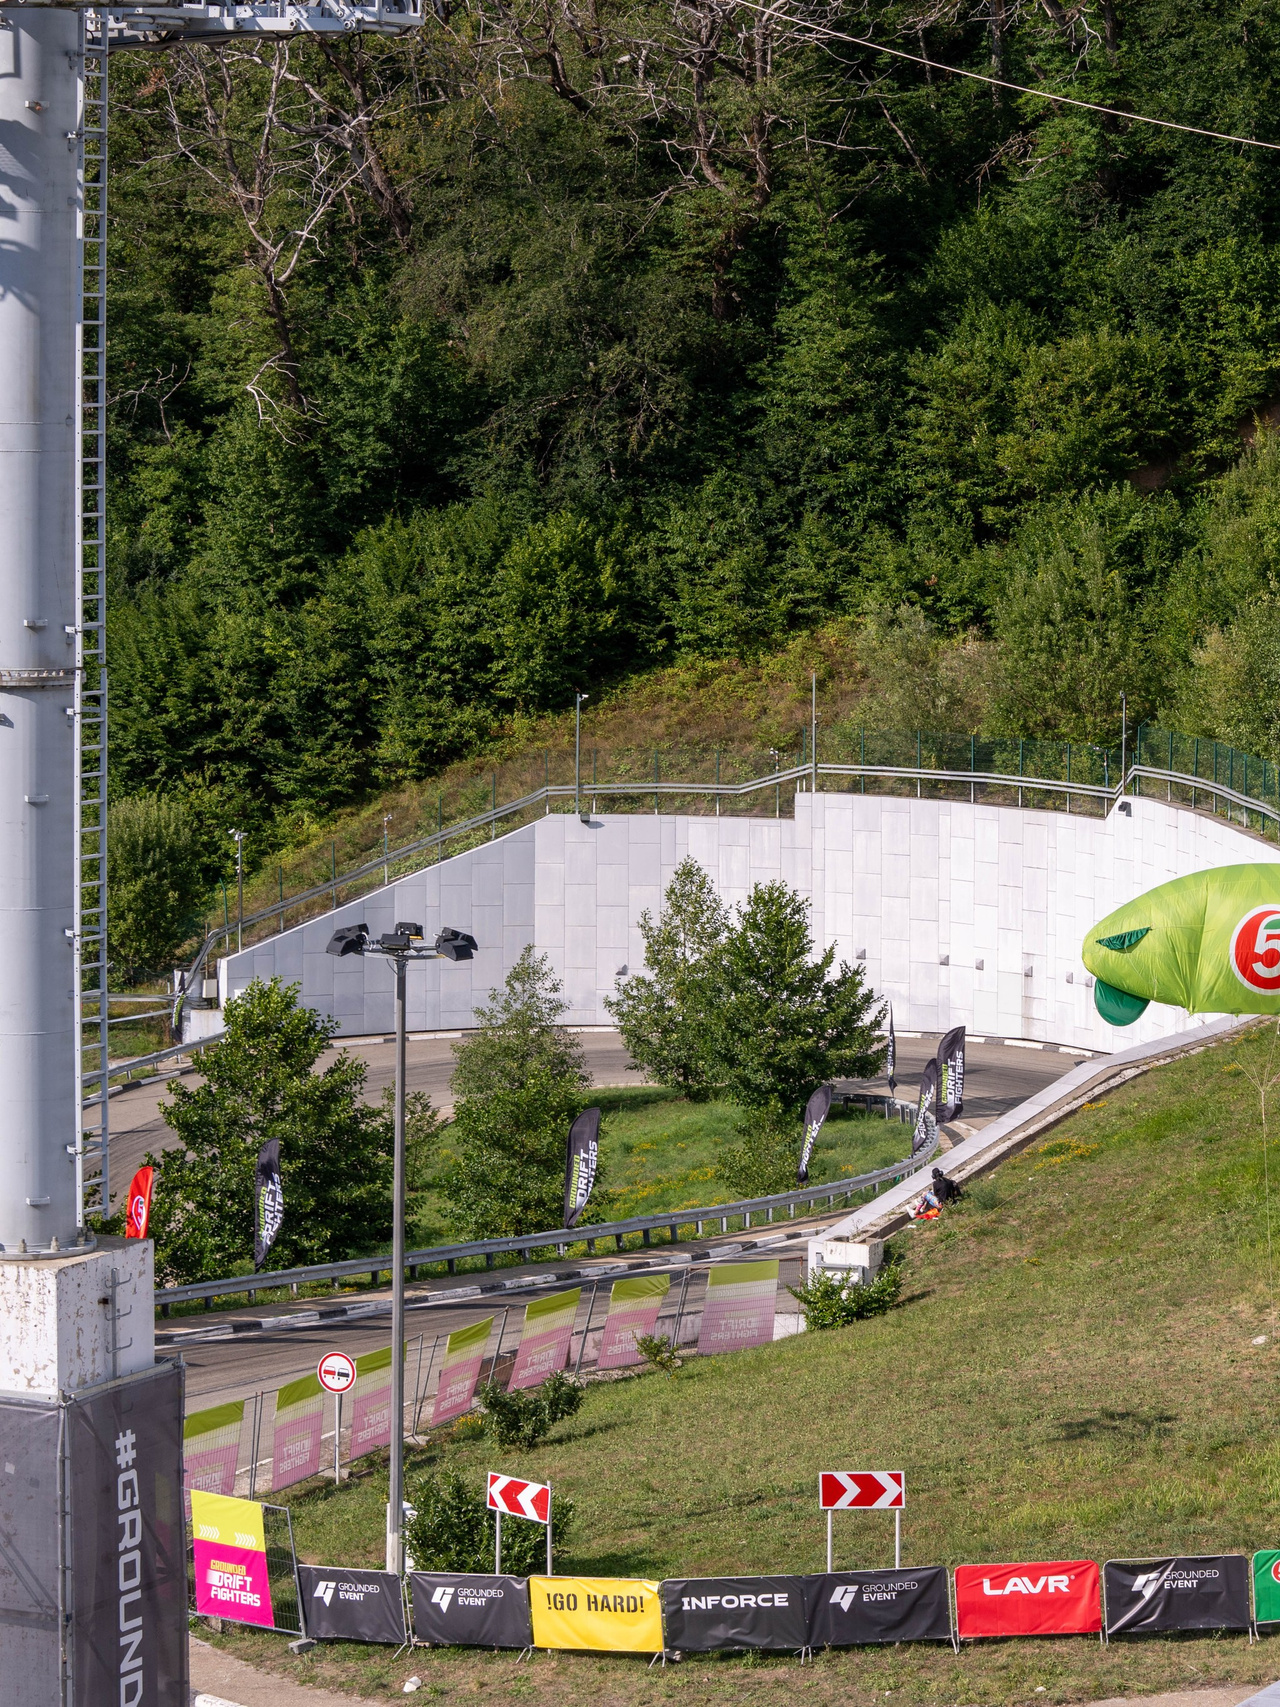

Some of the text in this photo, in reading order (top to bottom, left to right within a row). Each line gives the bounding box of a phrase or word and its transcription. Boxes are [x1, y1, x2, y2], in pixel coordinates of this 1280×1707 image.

[947, 1059, 957, 1101] DRIFT
[955, 1050, 964, 1105] FIGHTERS
[569, 1154, 580, 1209] GROUNDED
[576, 1149, 589, 1208] DRIFT
[210, 1559, 247, 1576] GROUNDED
[1164, 1569, 1220, 1580] GROUNDED
[207, 1569, 253, 1592] DRIFT
[338, 1582, 380, 1593] GROUNDED
[862, 1581, 918, 1593] GROUNDED
[982, 1574, 1071, 1596] LAVR
[1164, 1579, 1199, 1589] EVENT
[210, 1586, 261, 1607] FIGHTERS
[339, 1591, 365, 1601] EVENT
[457, 1587, 504, 1598] GROUNDED
[457, 1597, 487, 1606] EVENT
[681, 1592, 790, 1611] INFORCE
[862, 1591, 898, 1602] EVENT
[546, 1592, 645, 1613] !GO HARD!
